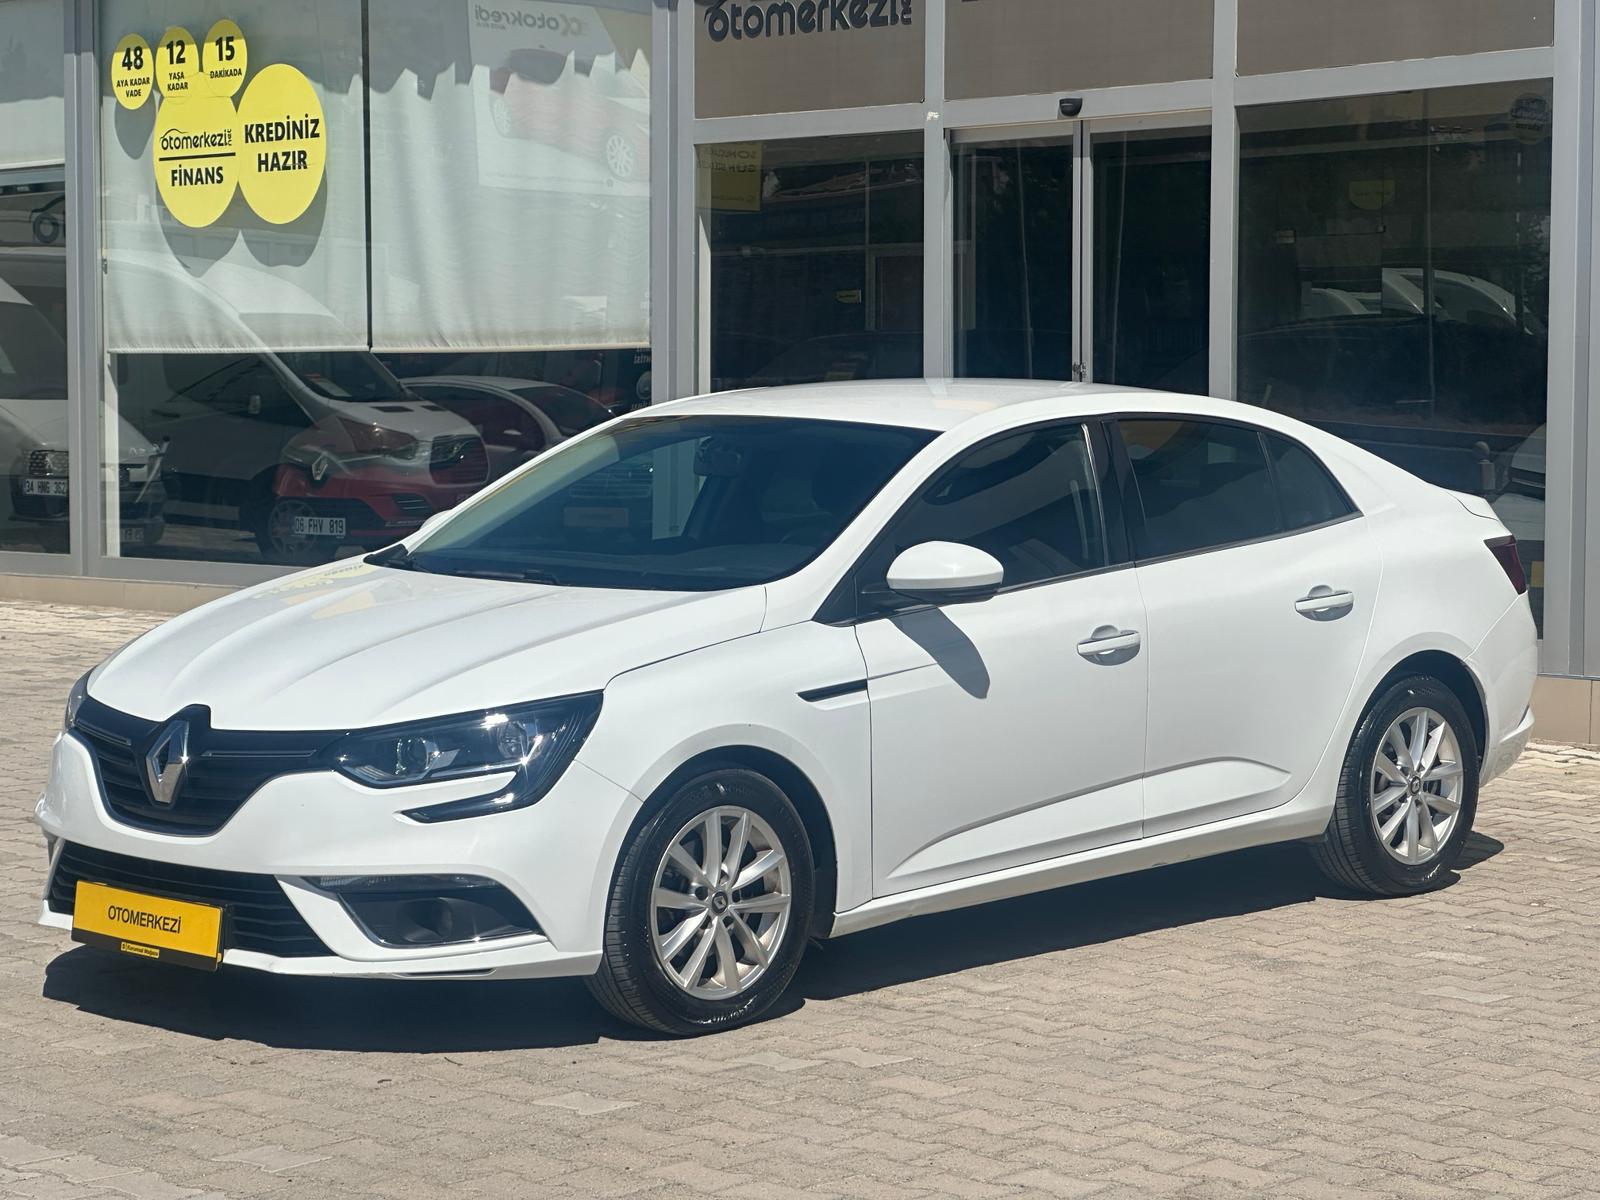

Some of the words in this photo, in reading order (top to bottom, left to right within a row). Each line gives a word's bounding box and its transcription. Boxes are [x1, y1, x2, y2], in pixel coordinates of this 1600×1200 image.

[122, 46, 143, 70] 48
[166, 40, 186, 65] 12
[215, 36, 235, 62] 15
[116, 79, 128, 88] AYA
[130, 77, 150, 86] KADAR
[168, 71, 184, 81] YAŞA
[210, 68, 242, 79] DAKİKADA
[125, 89, 142, 98] VADE
[167, 82, 188, 91] KADAR
[161, 129, 227, 150] otomerkezi
[244, 113, 320, 144] KREDİNİZ
[257, 150, 308, 173] HAZIR
[171, 164, 224, 187] FİNANS
[108, 905, 182, 934] OTOMERKEZİ
